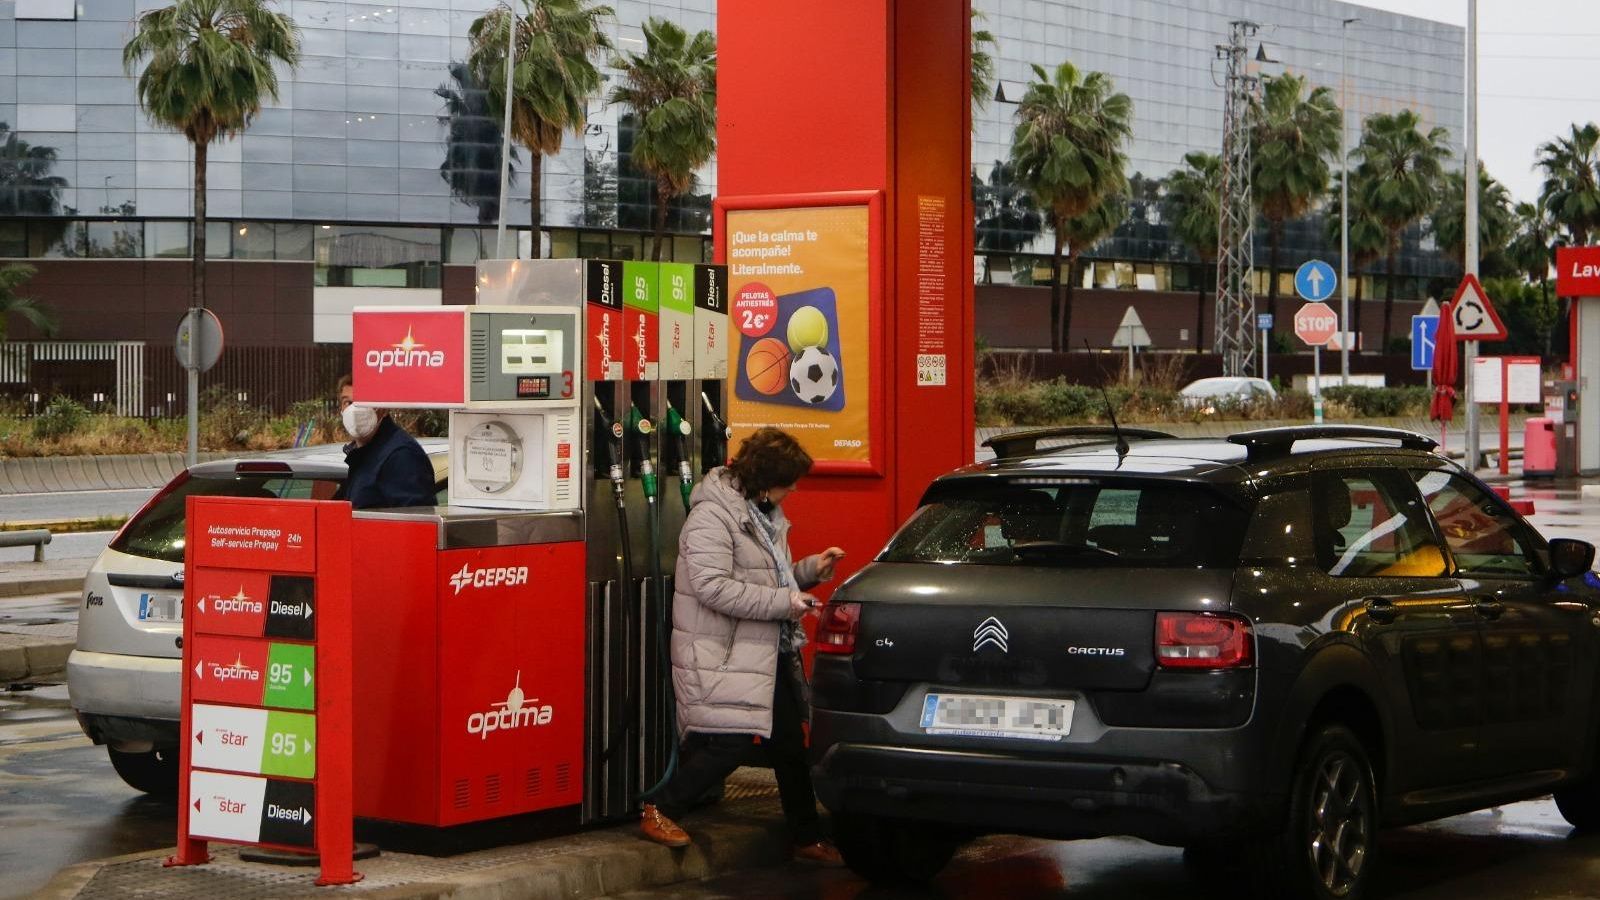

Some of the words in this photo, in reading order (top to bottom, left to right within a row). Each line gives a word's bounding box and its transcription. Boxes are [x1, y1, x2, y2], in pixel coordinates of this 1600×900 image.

[732, 231, 757, 245] ¡Que
[758, 231, 769, 242] la
[770, 230, 804, 242] calma
[806, 230, 818, 241] te
[732, 245, 791, 259] acompañe!
[732, 263, 804, 275] Literalmente.
[601, 263, 610, 304] Diesel
[635, 276, 646, 301] 95
[672, 275, 684, 301] 95
[707, 268, 716, 308] Diesel
[741, 292, 769, 300] PELOTAS
[1298, 317, 1334, 331] STOP
[603, 313, 611, 367] optima
[639, 314, 647, 367] optima
[673, 321, 681, 350] star
[708, 321, 716, 349] star
[366, 348, 444, 373] optima
[560, 370, 574, 398] 3
[207, 525, 251, 536] Autoservicio
[251, 527, 281, 539] Prepago
[287, 534, 302, 543] 24h
[211, 538, 253, 549] Self-service
[253, 540, 279, 551] Prepay
[473, 566, 529, 588] CEPSA
[214, 598, 263, 615] optima
[270, 600, 303, 616] Diesel
[1067, 646, 1125, 656] CACTUS
[213, 665, 260, 682] optima
[269, 662, 293, 684] 95
[467, 704, 553, 740] optima
[221, 732, 248, 746] star
[271, 731, 297, 756] 95
[219, 799, 246, 814] star
[267, 804, 302, 821] Diesel
